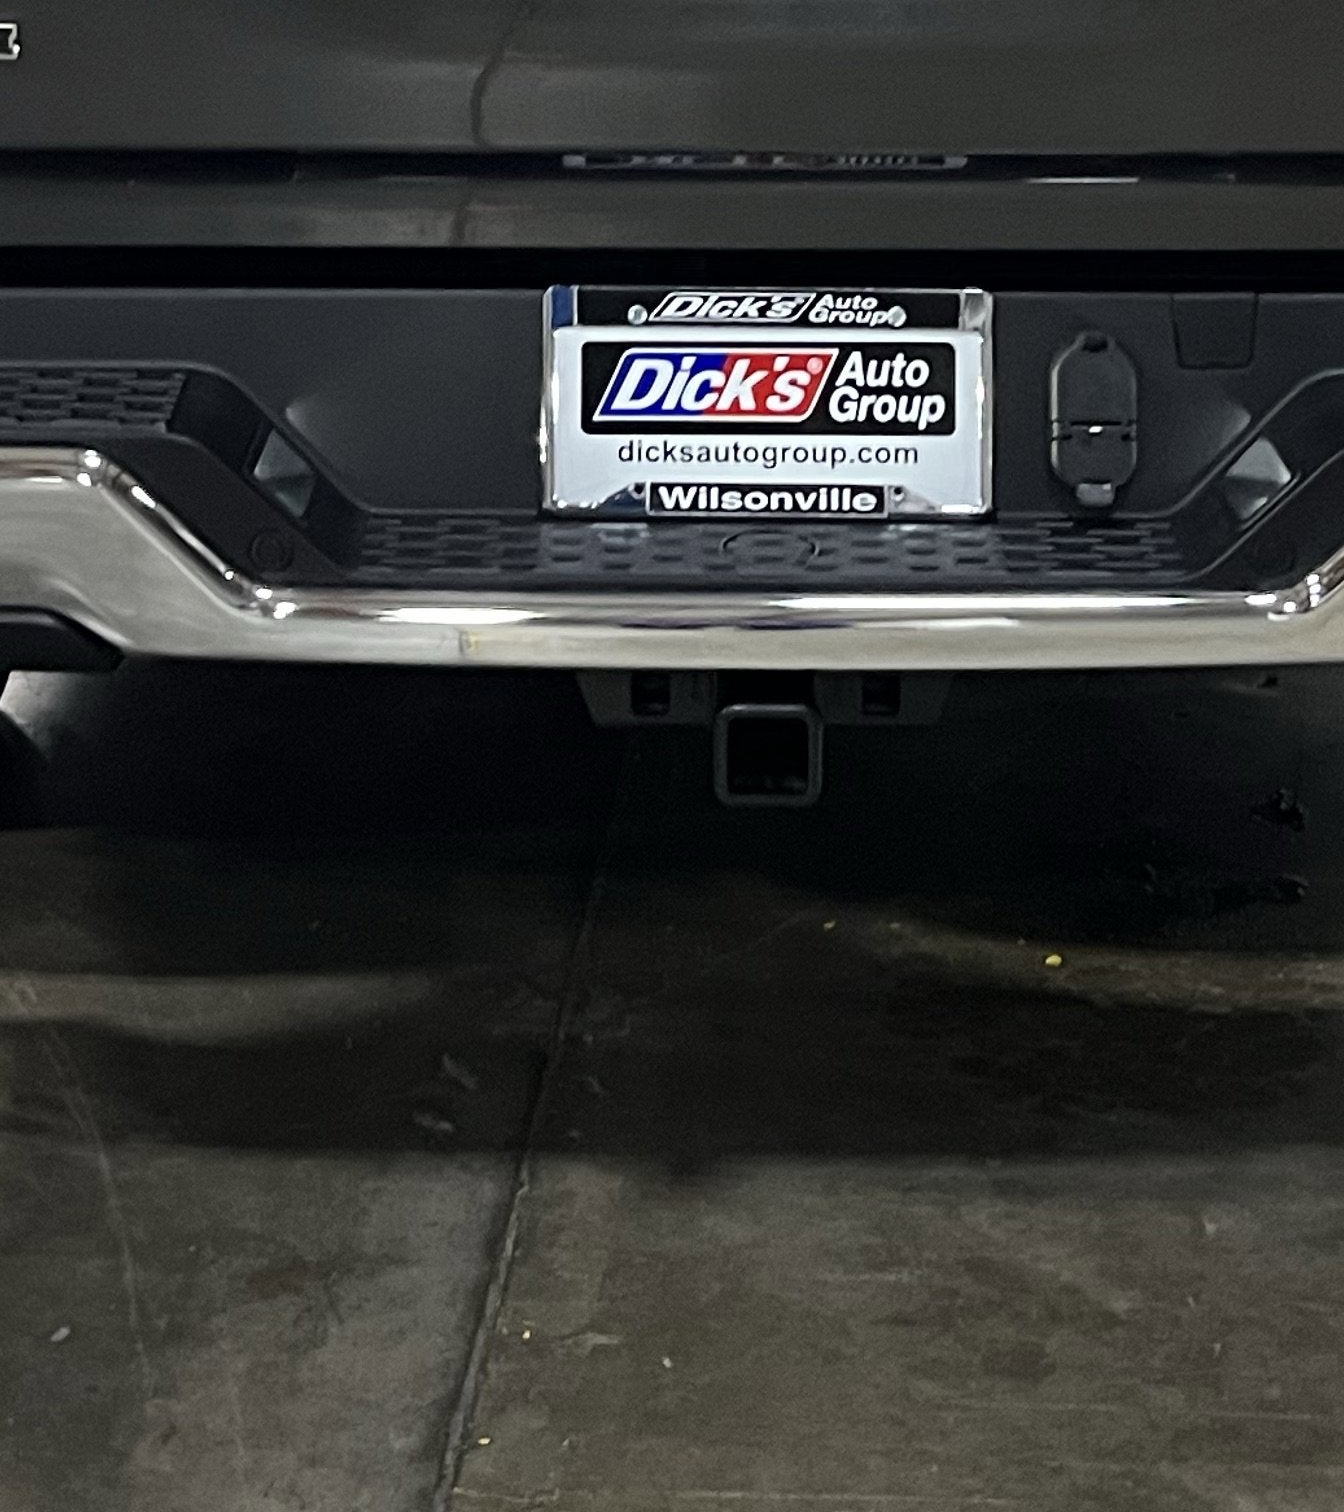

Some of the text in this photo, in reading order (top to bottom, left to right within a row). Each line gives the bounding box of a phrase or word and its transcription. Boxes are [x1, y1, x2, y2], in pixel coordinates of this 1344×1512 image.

[662, 294, 878, 321] Dick's Auto
[809, 308, 894, 327] Group
[610, 351, 930, 412] Dick's Auto
[828, 388, 946, 431] Group
[618, 439, 919, 469] dicksautogroup.com
[657, 485, 877, 513] Wilsonville
